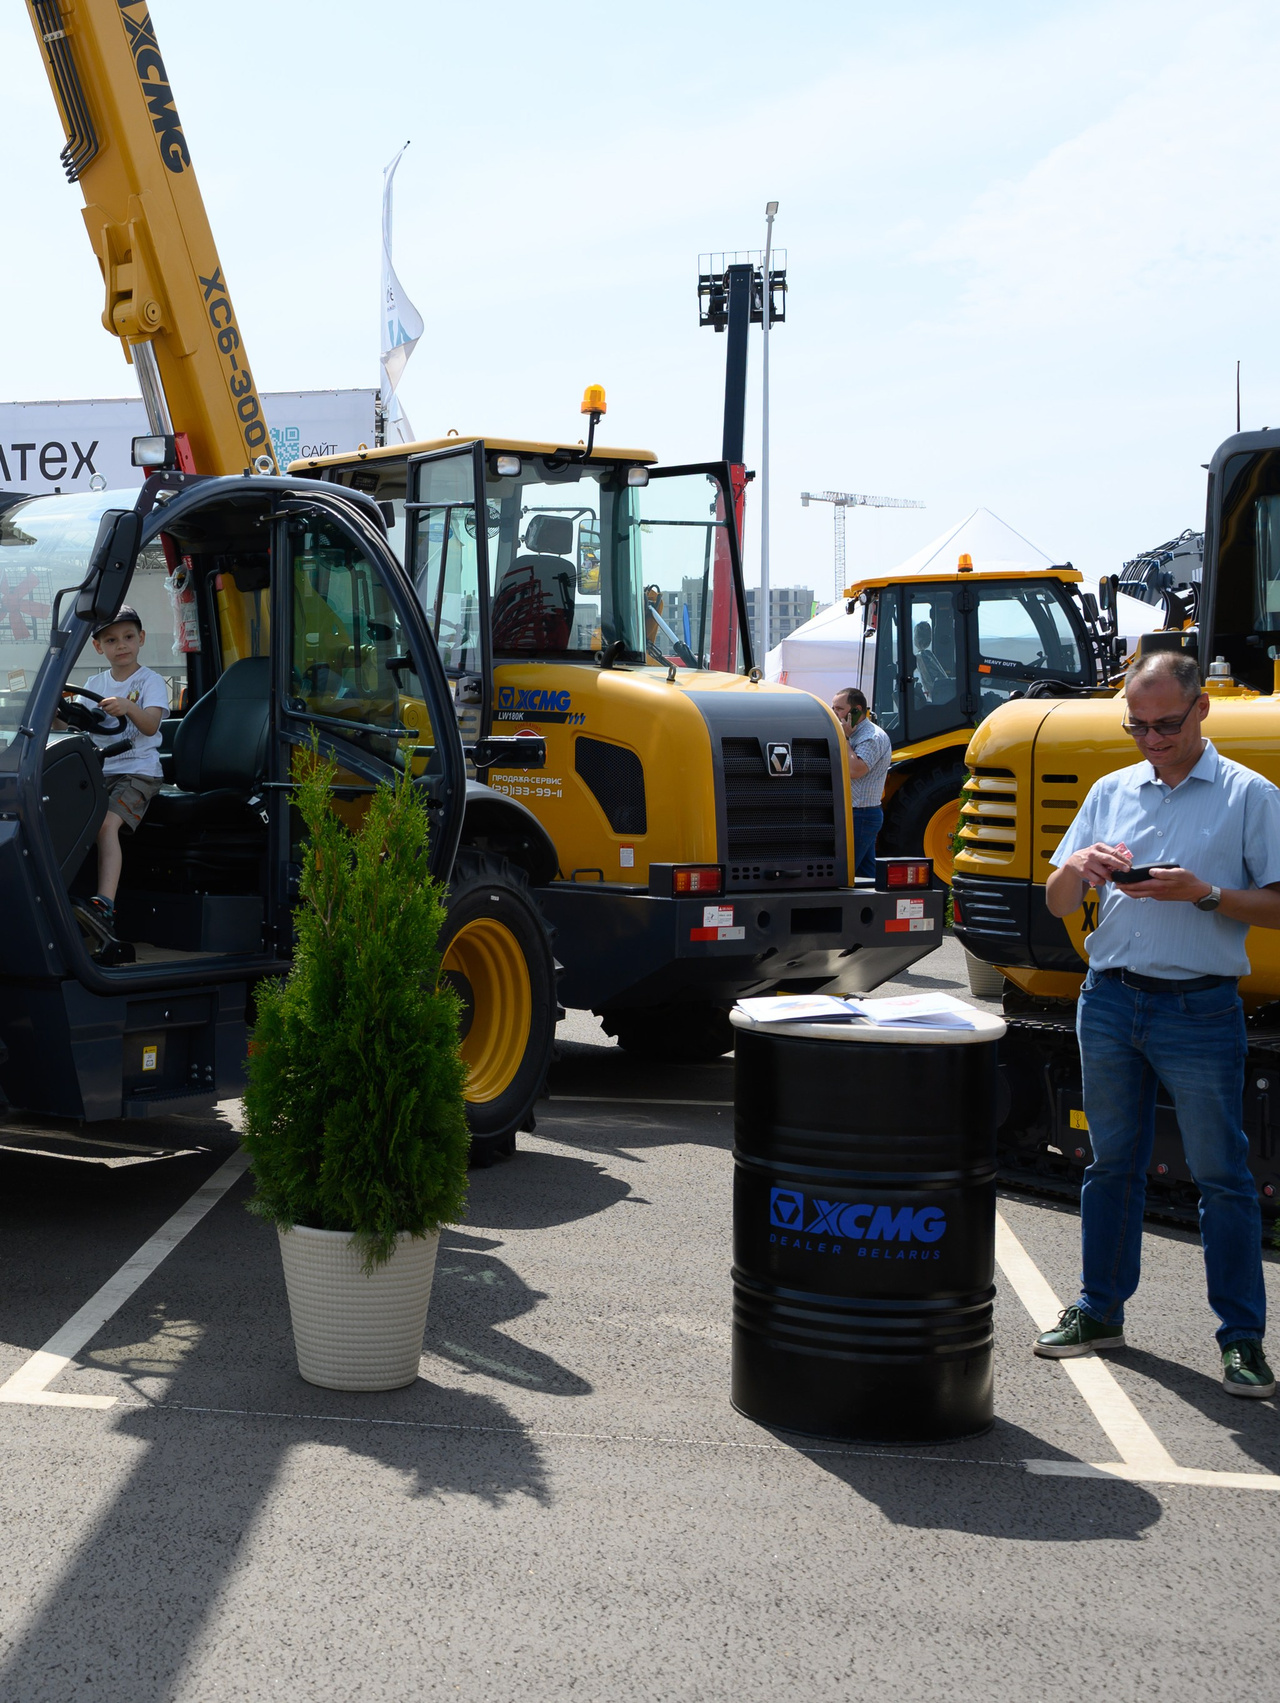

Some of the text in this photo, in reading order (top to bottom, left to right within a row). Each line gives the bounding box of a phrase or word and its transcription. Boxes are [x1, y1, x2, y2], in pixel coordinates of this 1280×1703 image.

[120, 10, 191, 174] XCMG
[301, 442, 338, 458] САЙТ
[983, 658, 1002, 666] HEAVY
[514, 689, 571, 712] XCMG
[497, 711, 525, 721] LW180K
[803, 1199, 947, 1243] XCMG
[769, 1232, 942, 1260] DEALER BELARUS
